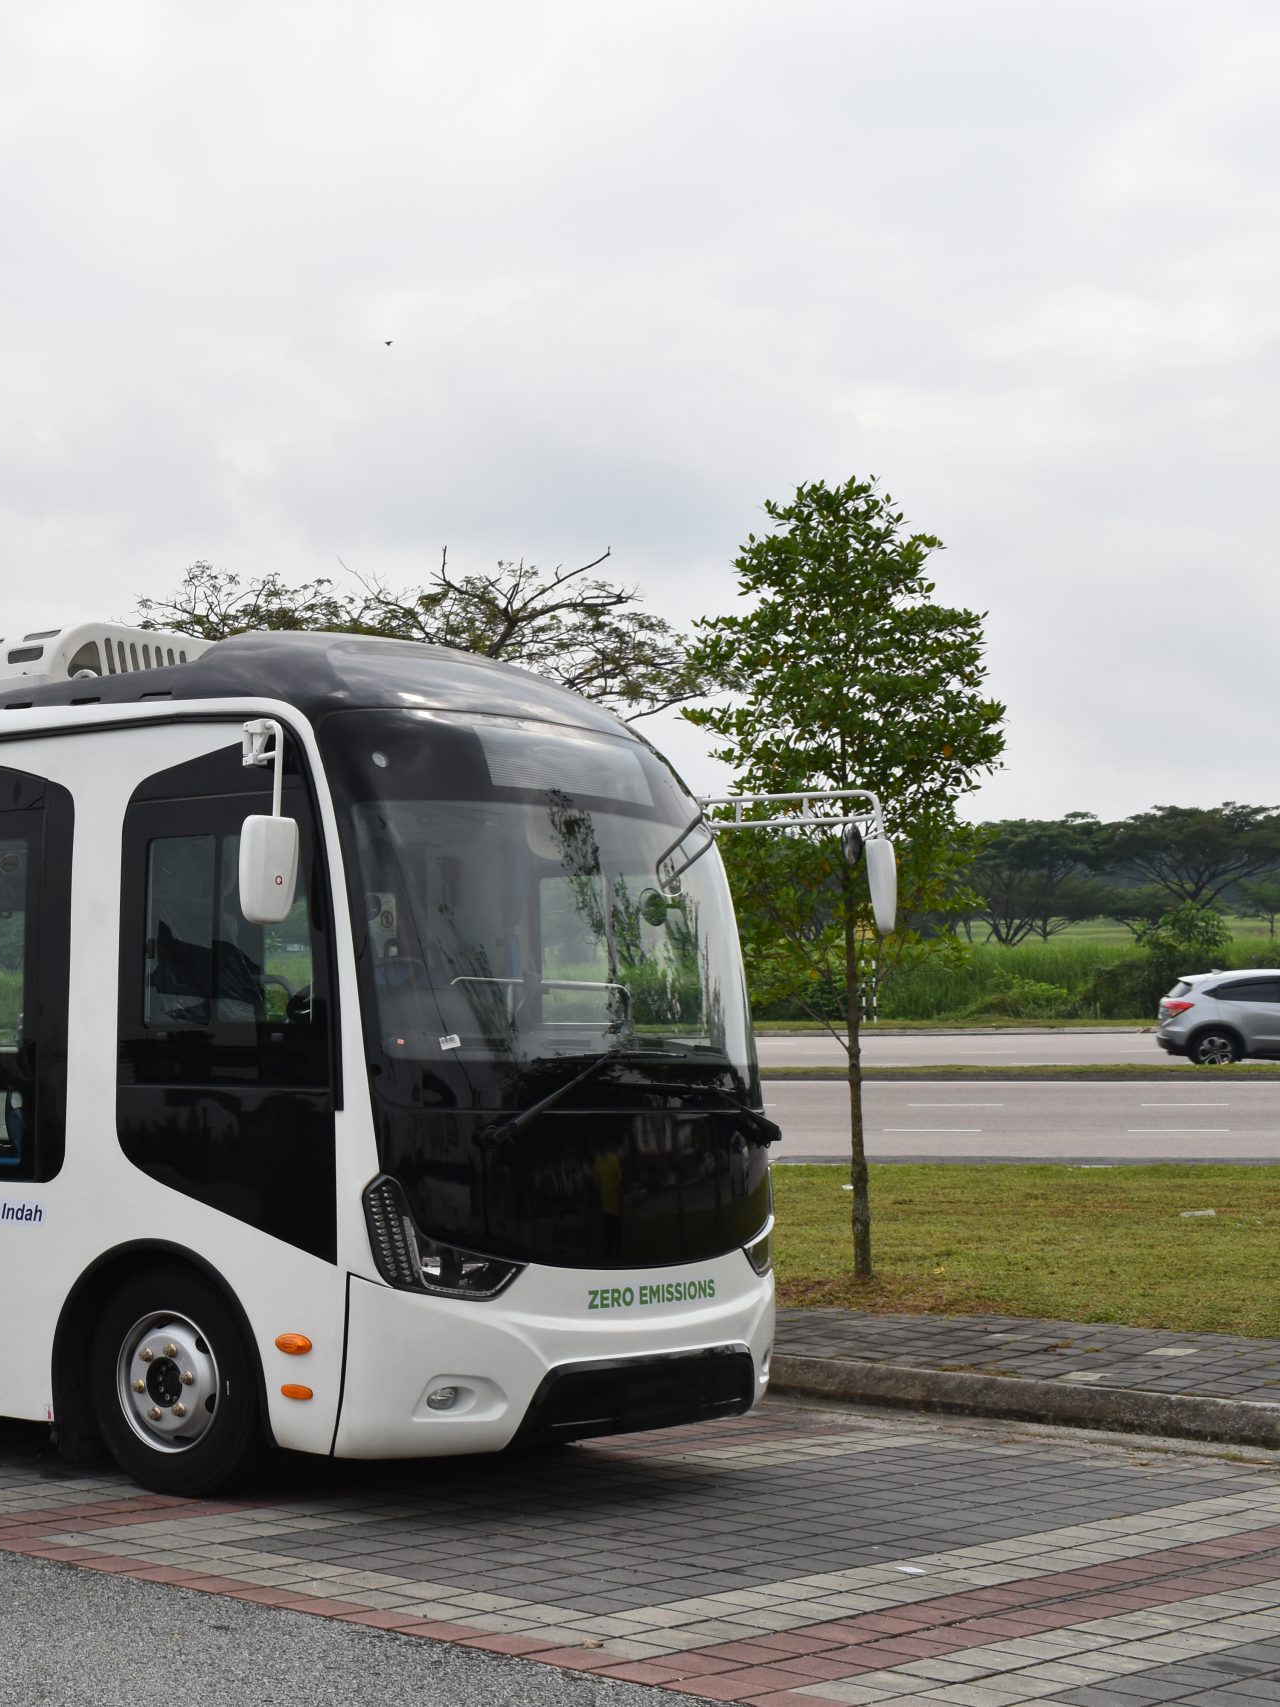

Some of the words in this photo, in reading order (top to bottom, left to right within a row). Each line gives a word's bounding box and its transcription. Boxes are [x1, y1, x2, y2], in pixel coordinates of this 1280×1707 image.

[1, 1203, 43, 1222] Indah
[587, 1287, 635, 1310] ZERO
[639, 1279, 716, 1306] EMISSIONS
